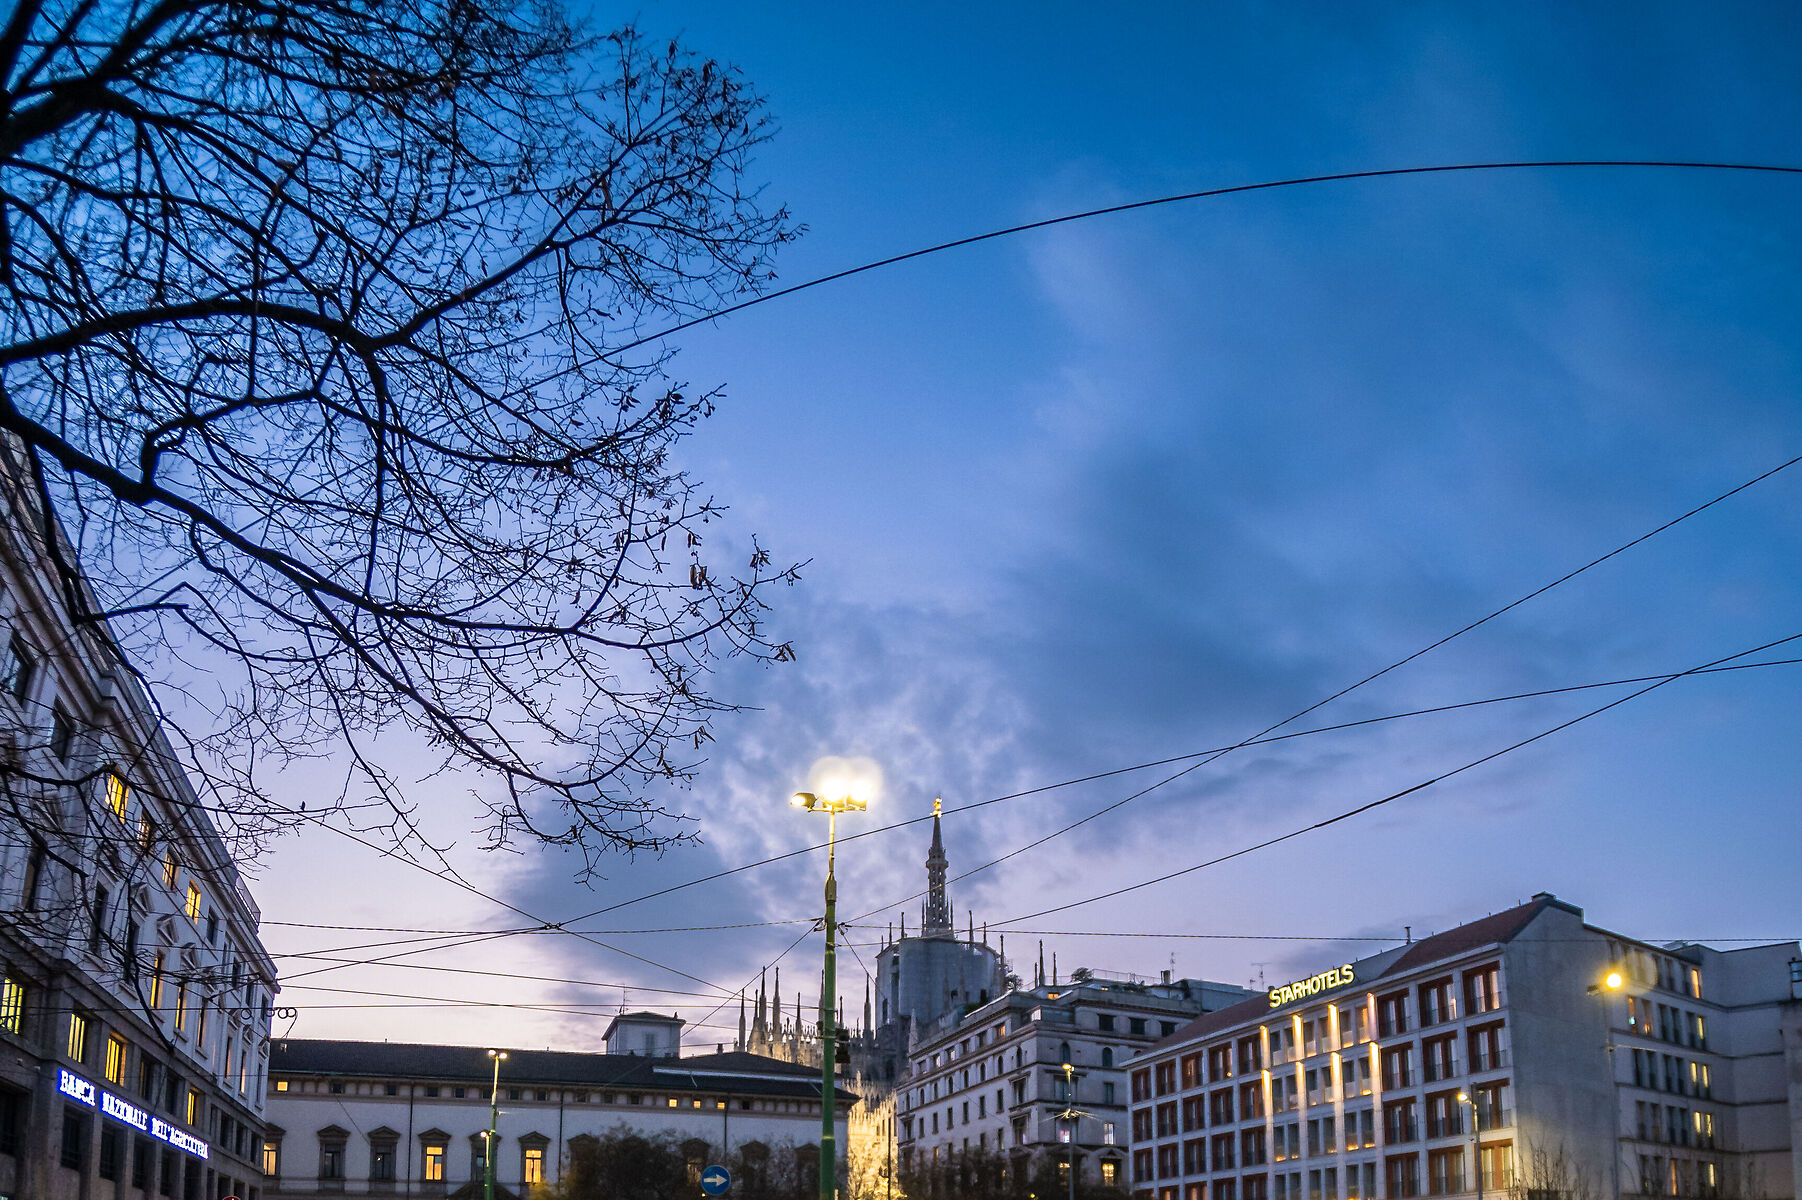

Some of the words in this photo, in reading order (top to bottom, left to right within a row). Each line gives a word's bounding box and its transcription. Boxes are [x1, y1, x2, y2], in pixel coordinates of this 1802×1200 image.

[1268, 963, 1355, 1008] STARHOTELS
[59, 1070, 96, 1106] BANCA
[102, 1092, 148, 1131] NAZIONALE
